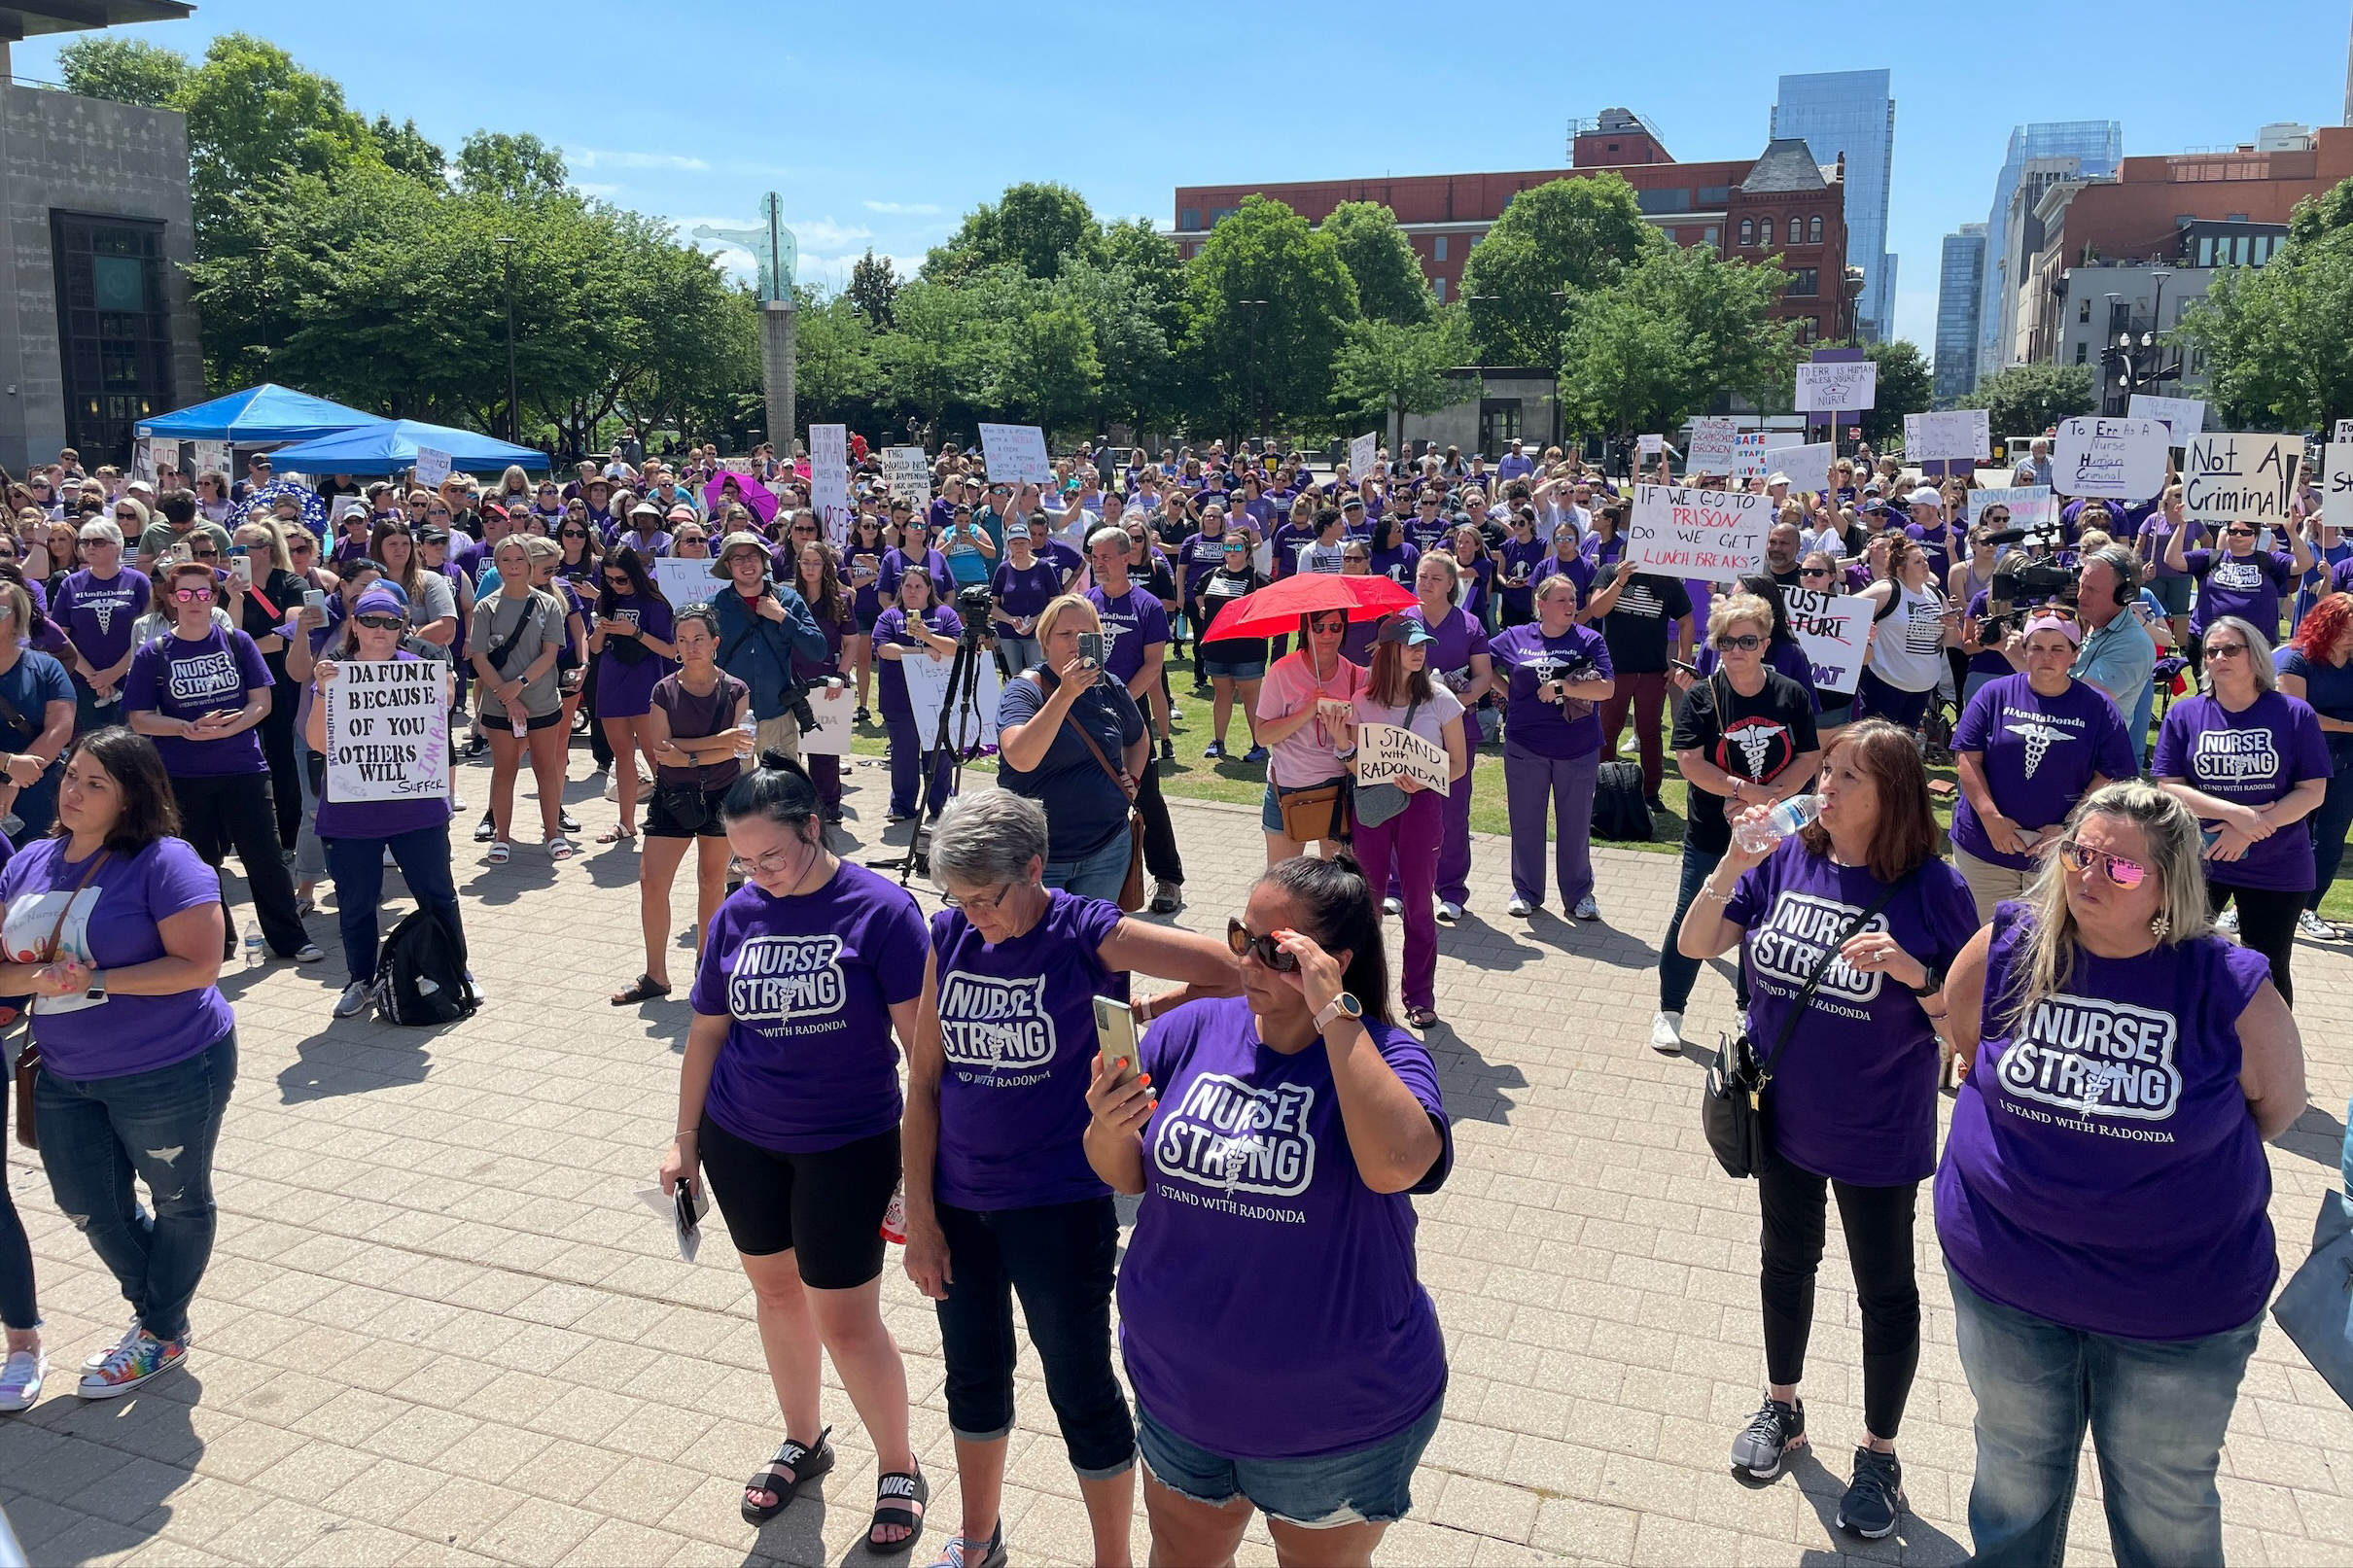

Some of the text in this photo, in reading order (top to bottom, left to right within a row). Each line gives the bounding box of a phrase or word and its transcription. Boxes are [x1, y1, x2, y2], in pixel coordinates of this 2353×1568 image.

[1798, 364, 1875, 377] TO ERR IS HUMAN
[1806, 376, 1832, 385] UNLESS
[1817, 396, 1848, 406] NURSE
[1701, 420, 1737, 430] NURSES
[2070, 420, 2150, 436] To Err As A
[1694, 433, 1736, 443] SCAPEGOATS
[1735, 435, 1766, 445] SAFE
[2090, 437, 2126, 452] Nurse
[812, 441, 845, 467] HUMAN
[886, 449, 903, 459] THIS
[1693, 443, 1731, 454] BROKEN
[436, 458, 449, 469] NOT
[884, 461, 926, 470] WOULD NOT
[1773, 452, 1806, 468] Where
[2080, 453, 2125, 466] Human
[2192, 438, 2284, 480] Not A
[813, 468, 832, 480] UNLESS
[885, 472, 929, 481] BE HAPPENING
[1738, 467, 1768, 476] LIVES
[2075, 468, 2122, 480] Criminal
[1641, 486, 1756, 509] IF WE GO TO
[1631, 526, 1758, 549] DO WE GET
[1643, 548, 1760, 571] LUNCH BREAKS?
[663, 564, 686, 580] To
[1795, 612, 1849, 638] TURE
[1518, 647, 1578, 657] #IAmRaDonda
[175, 654, 228, 678] NURSE
[348, 686, 436, 710] BECAUSE
[349, 716, 426, 737] OF YOU
[2003, 707, 2086, 729] #IAmRaDonda
[1363, 727, 1442, 765] I STAND
[2204, 733, 2266, 752] NURSE
[338, 745, 417, 765] OTHERS
[1380, 749, 1410, 761] with
[358, 762, 406, 782] WILL
[1360, 761, 1447, 791] RADONDA!
[2223, 784, 2243, 792] WITH
[2243, 783, 2276, 791] RADONDA
[742, 944, 833, 976] NURSE
[945, 981, 1034, 1021] NURSE
[1814, 998, 1872, 1022] RADONDA
[762, 1026, 793, 1038] WITH
[795, 1019, 848, 1036] RADONDA
[2031, 1002, 2163, 1064] NURSE
[973, 1073, 996, 1088] WITH
[996, 1069, 1052, 1088] RADONDA
[1186, 1083, 1302, 1133] NURSE
[1999, 1098, 2176, 1143] I STAND WITH RADONDA
[1155, 1182, 1307, 1224] I STAND WITH RADONDA
[878, 1476, 916, 1497] NIKE
